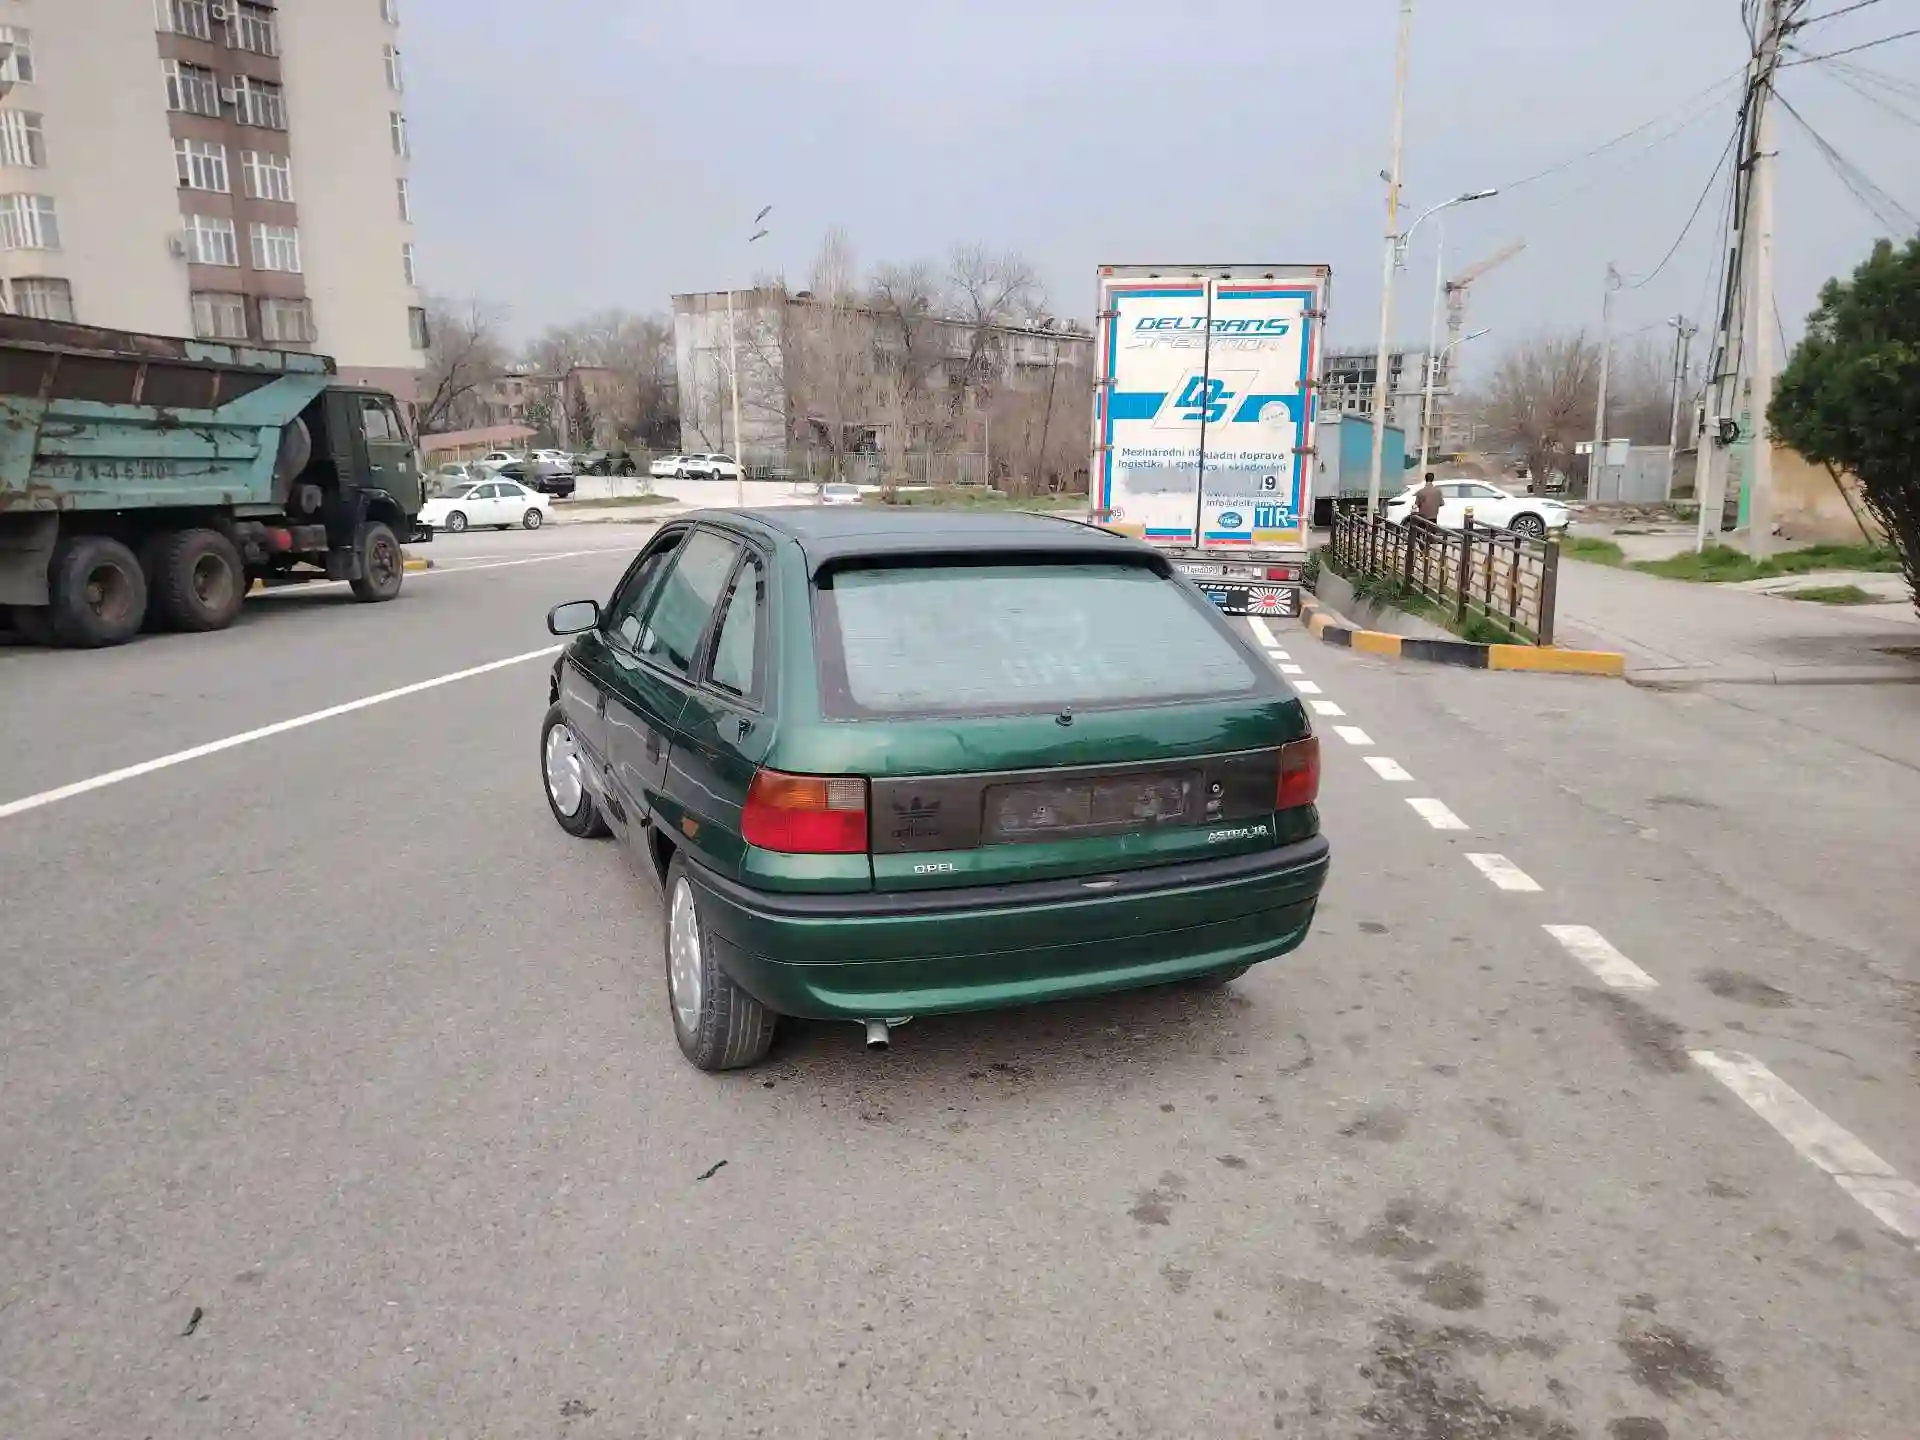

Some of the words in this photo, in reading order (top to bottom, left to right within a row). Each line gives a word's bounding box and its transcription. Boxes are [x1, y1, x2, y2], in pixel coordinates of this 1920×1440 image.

[1135, 316, 1291, 337] DELTRANS
[1264, 475, 1277, 490] 9
[1256, 507, 1289, 527] TIR
[914, 863, 960, 874] OPEL
